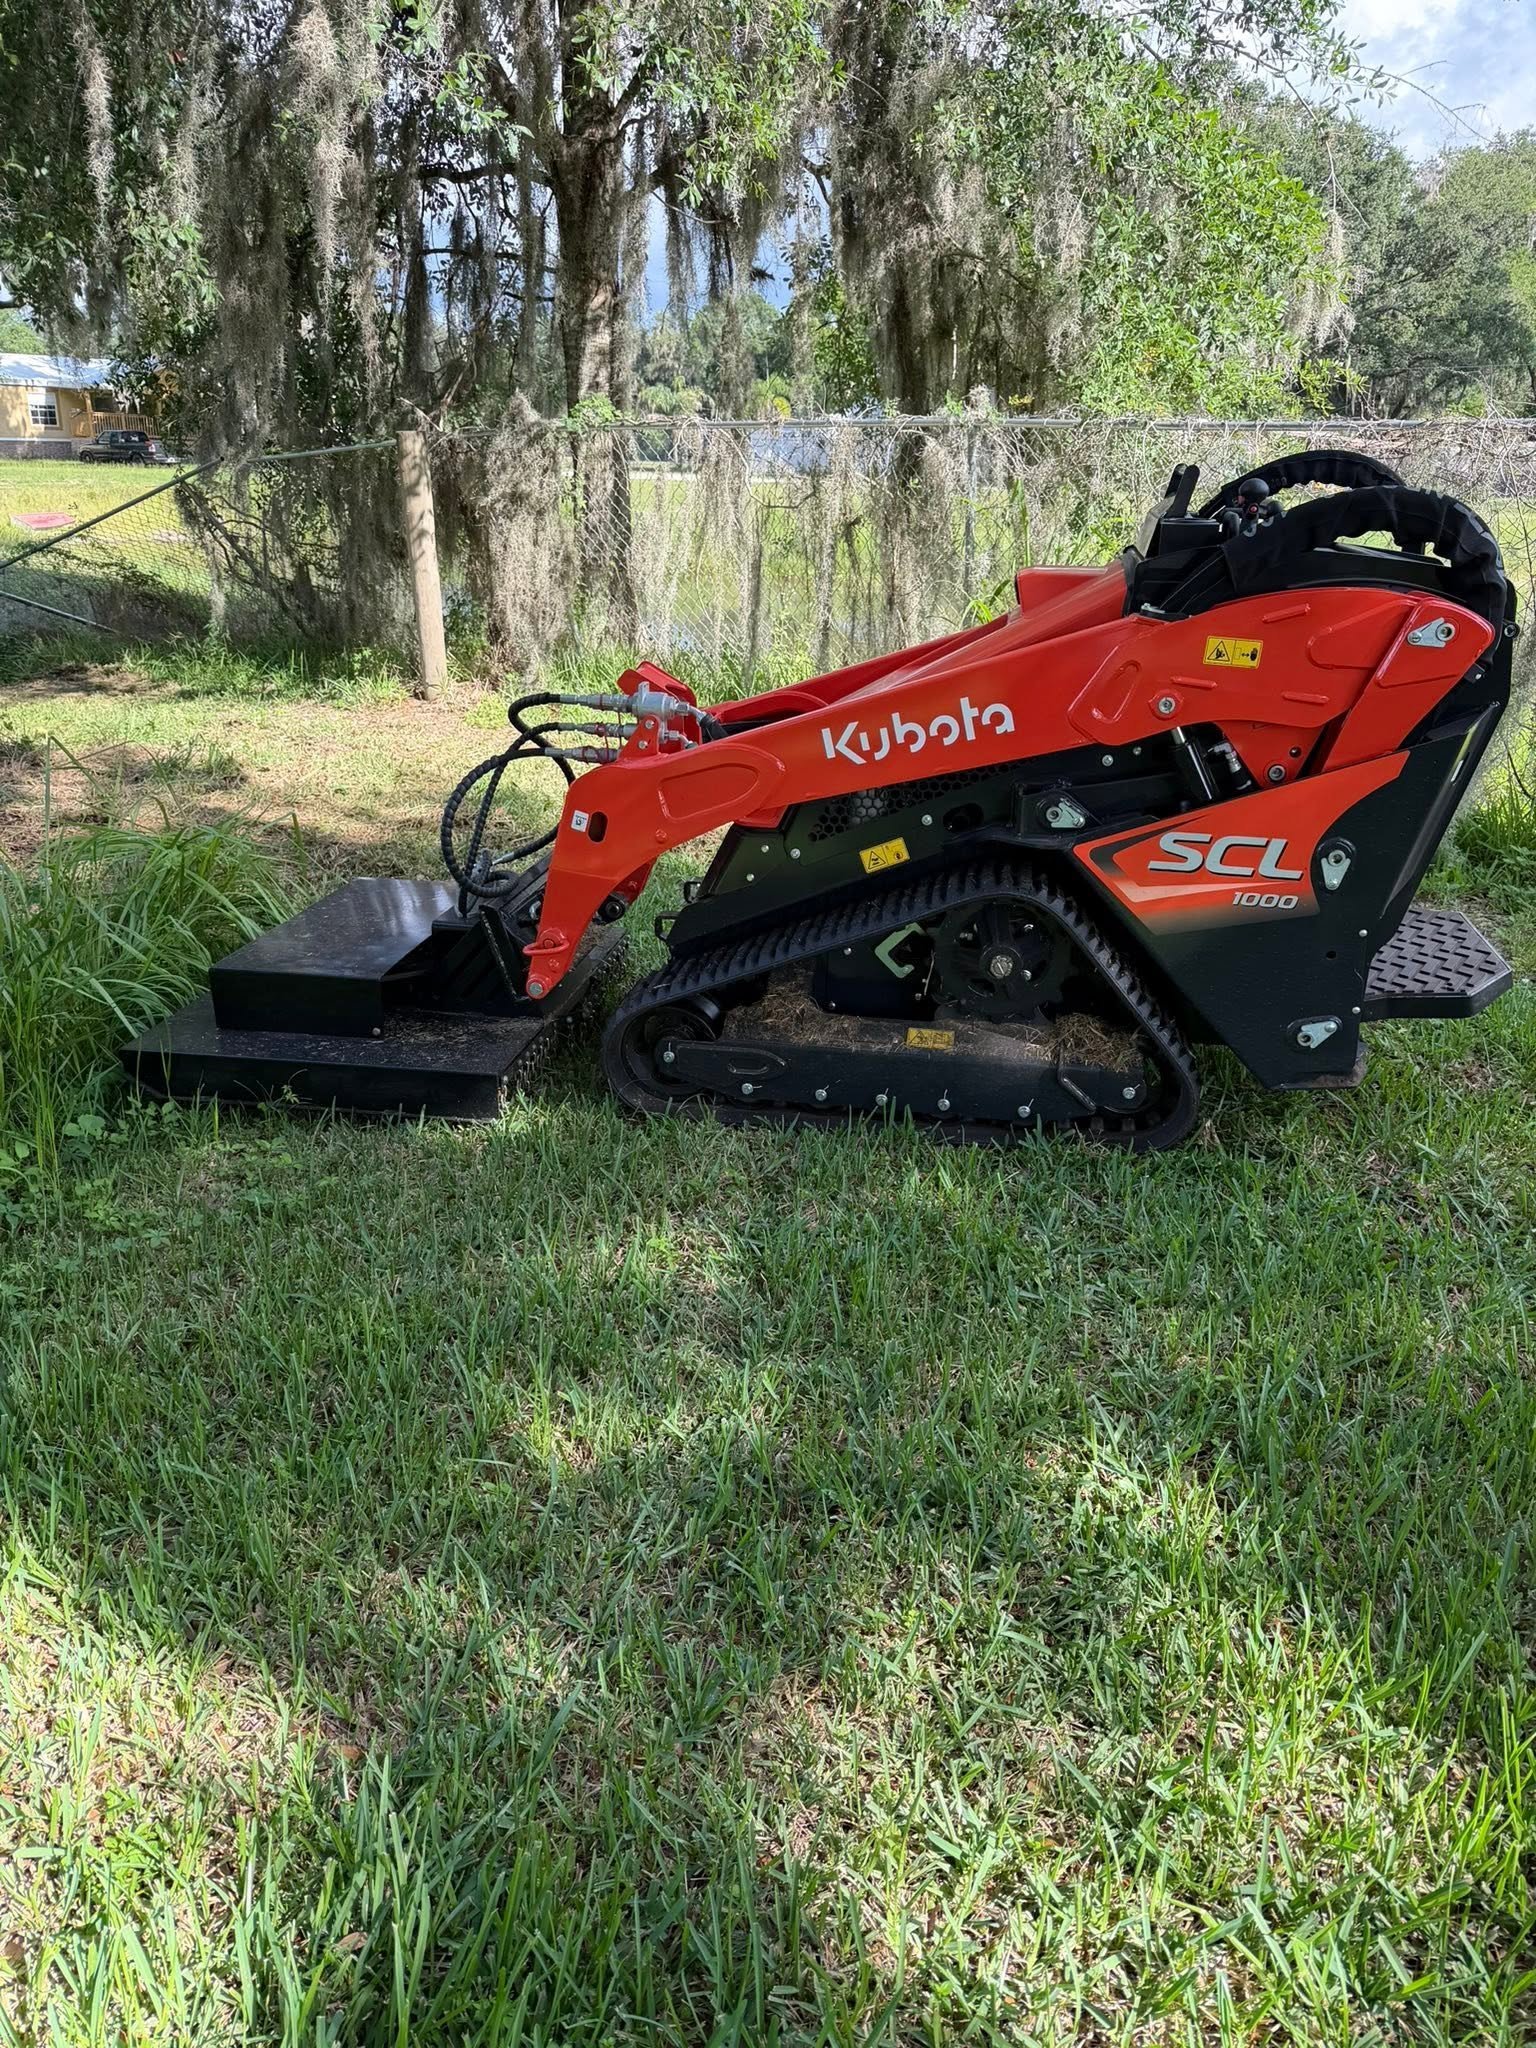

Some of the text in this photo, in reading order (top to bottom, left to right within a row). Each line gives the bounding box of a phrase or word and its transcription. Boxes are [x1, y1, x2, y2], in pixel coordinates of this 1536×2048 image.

[821, 697, 1015, 764] Kubota
[1148, 832, 1303, 879] SCL
[1232, 892, 1298, 909] 1000
